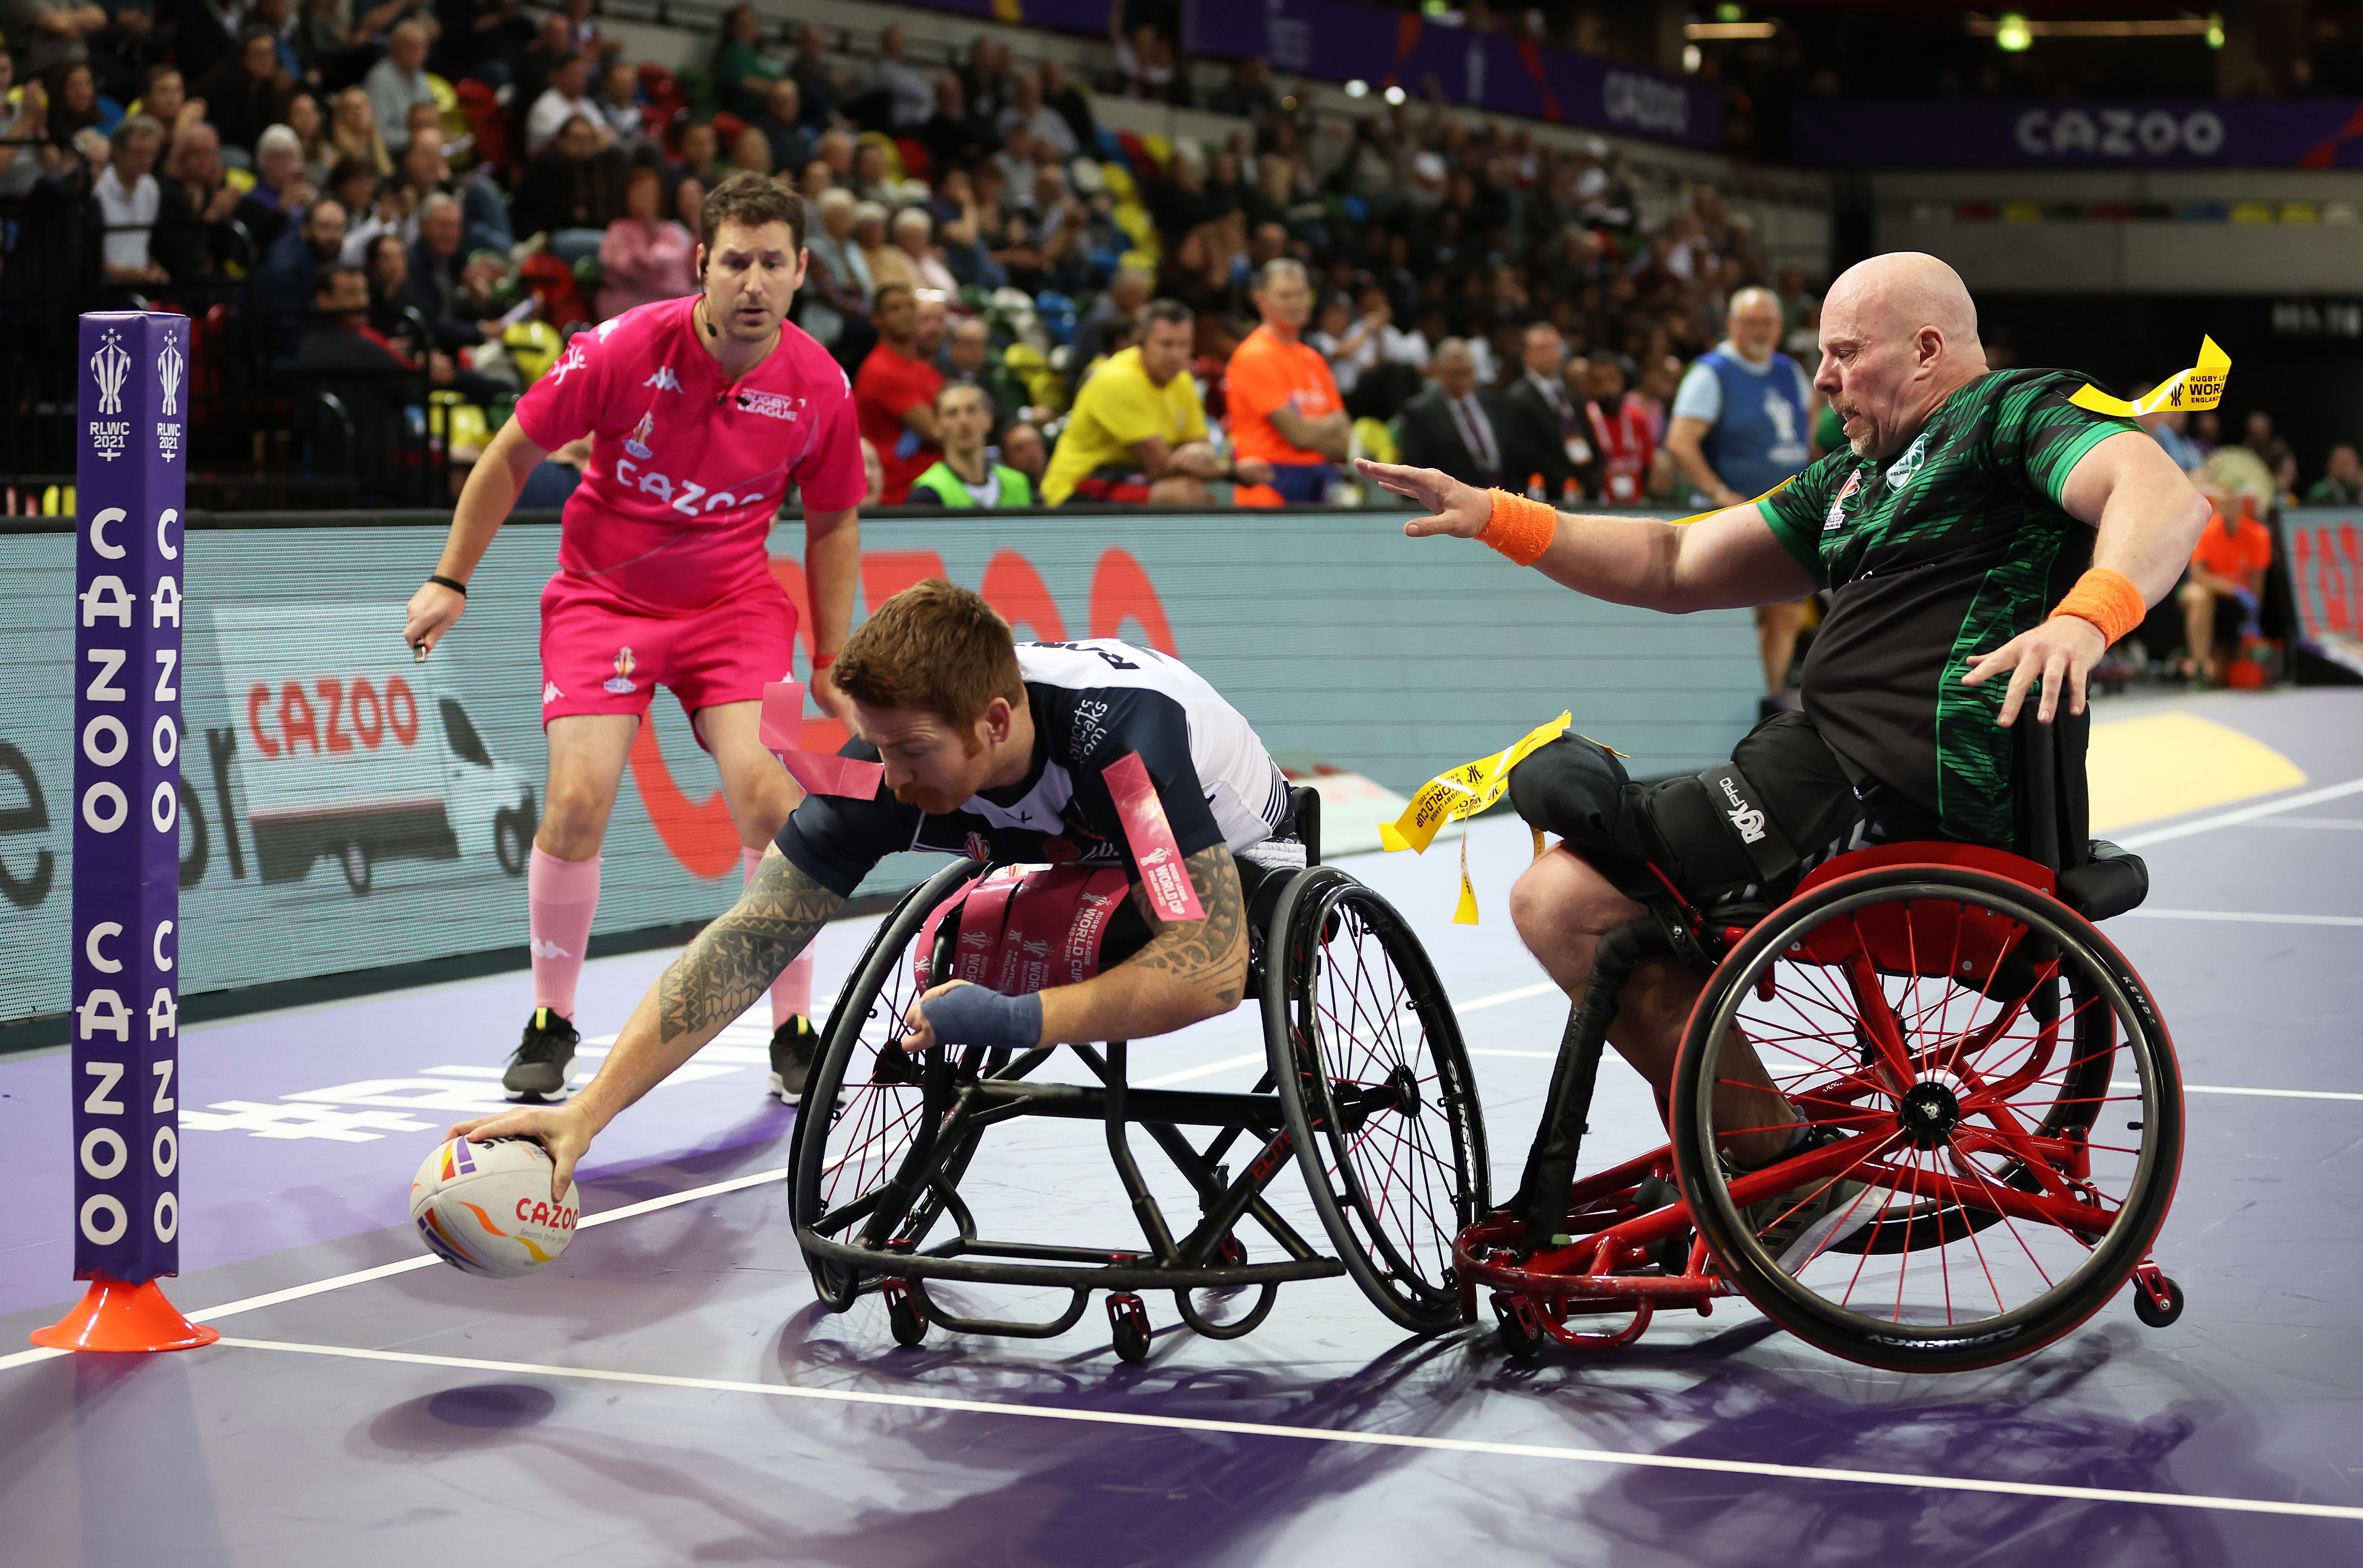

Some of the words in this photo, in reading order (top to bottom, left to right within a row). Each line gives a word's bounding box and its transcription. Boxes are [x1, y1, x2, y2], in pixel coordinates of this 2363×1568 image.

[2014, 108, 2225, 155] CAZOO
[90, 422, 130, 435] RLWC
[93, 435, 125, 449] 2021
[157, 422, 181, 437] RLWC
[159, 437, 178, 449] 2021
[79, 507, 137, 833] CAZOO
[150, 508, 182, 833] CAZOO
[249, 677, 419, 758] CAZOO
[1719, 777, 1745, 808] PRO
[1416, 808, 1429, 828] CUP
[1727, 802, 1767, 845] RGK
[1155, 864, 1179, 901] WORLD
[1168, 899, 1185, 914] CUP
[1072, 908, 1097, 956] WORLD
[1089, 911, 1104, 935] RUGBY
[1084, 935, 1094, 966] LEAGUE
[1070, 959, 1083, 983] CUP
[2122, 976, 2156, 1025] KENDA
[75, 921, 134, 1246] CAZOO
[147, 920, 178, 1243] CAZOO
[516, 1197, 579, 1231] CAZOO
